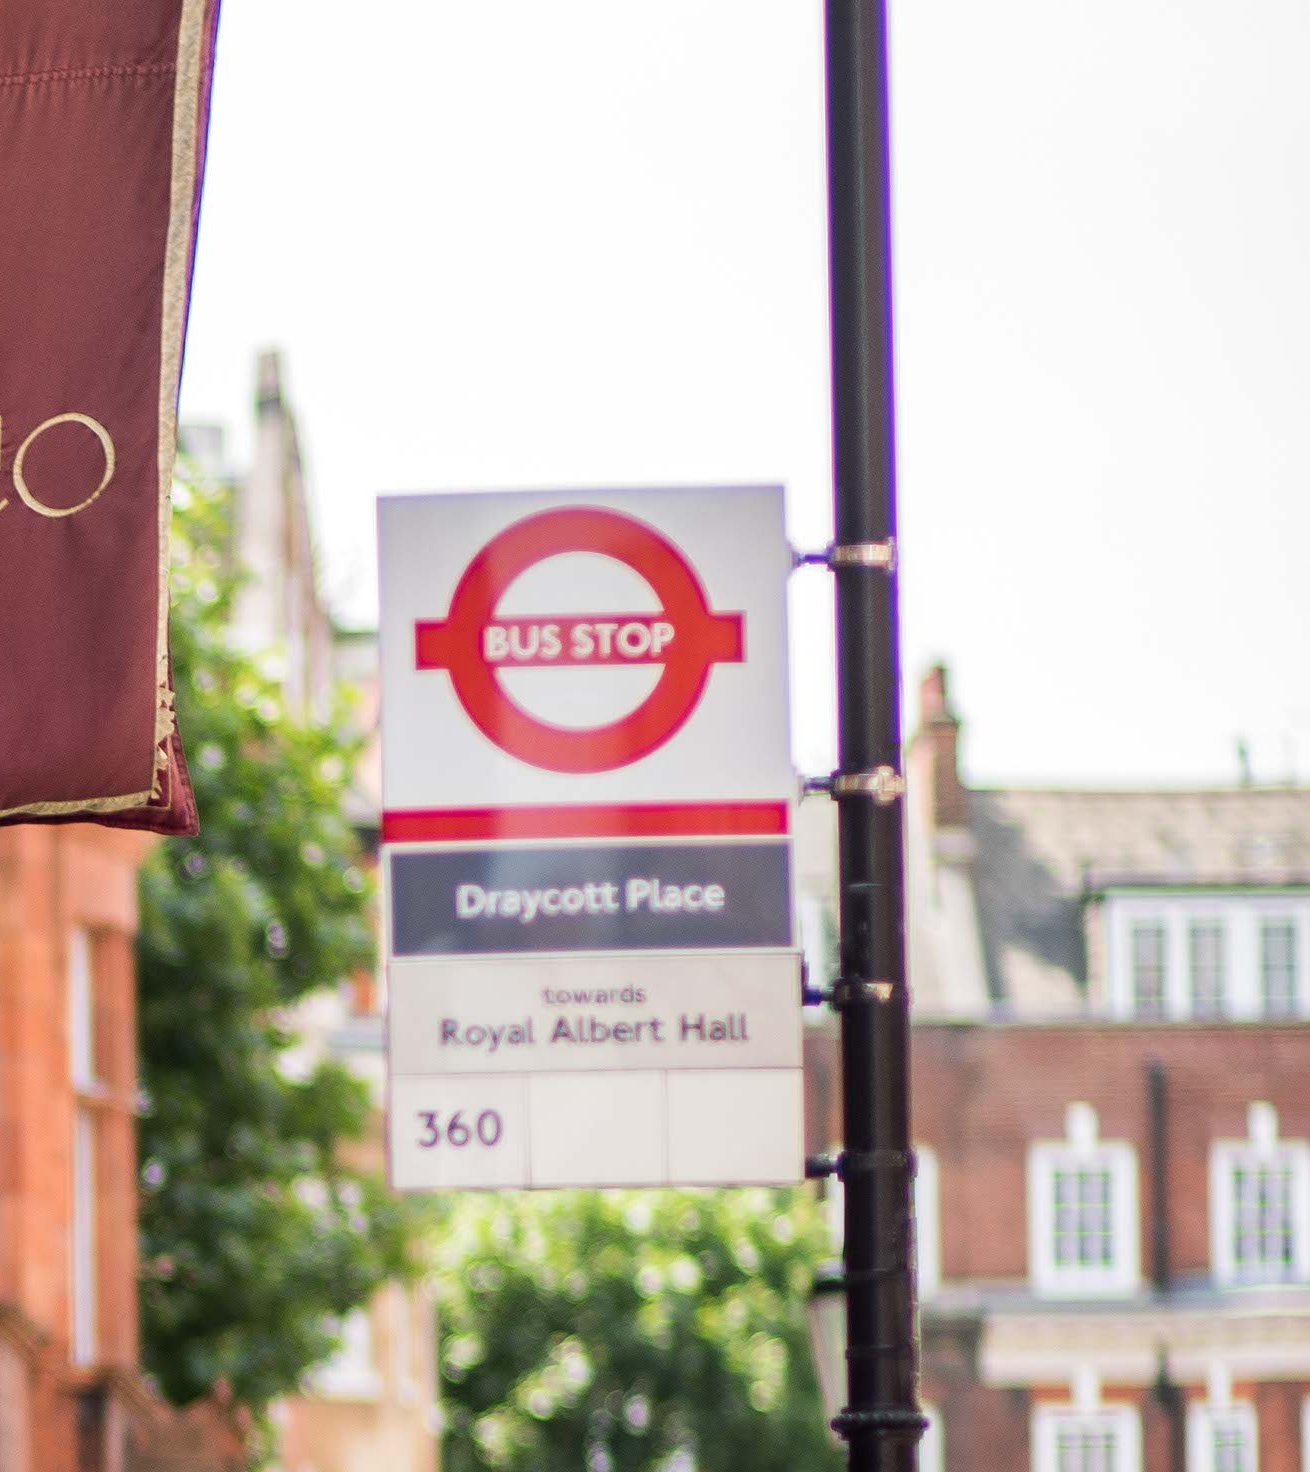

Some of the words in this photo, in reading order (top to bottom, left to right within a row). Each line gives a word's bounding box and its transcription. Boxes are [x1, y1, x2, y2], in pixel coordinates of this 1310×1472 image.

[484, 624, 563, 661] BUS
[570, 622, 675, 659] STOP
[455, 882, 620, 924] Draycott
[625, 877, 726, 913] Place
[540, 984, 647, 1005] towards
[438, 1016, 536, 1052] Royal
[548, 1015, 665, 1044] Albert
[677, 1011, 750, 1042] Hall
[415, 1108, 503, 1148] 360
